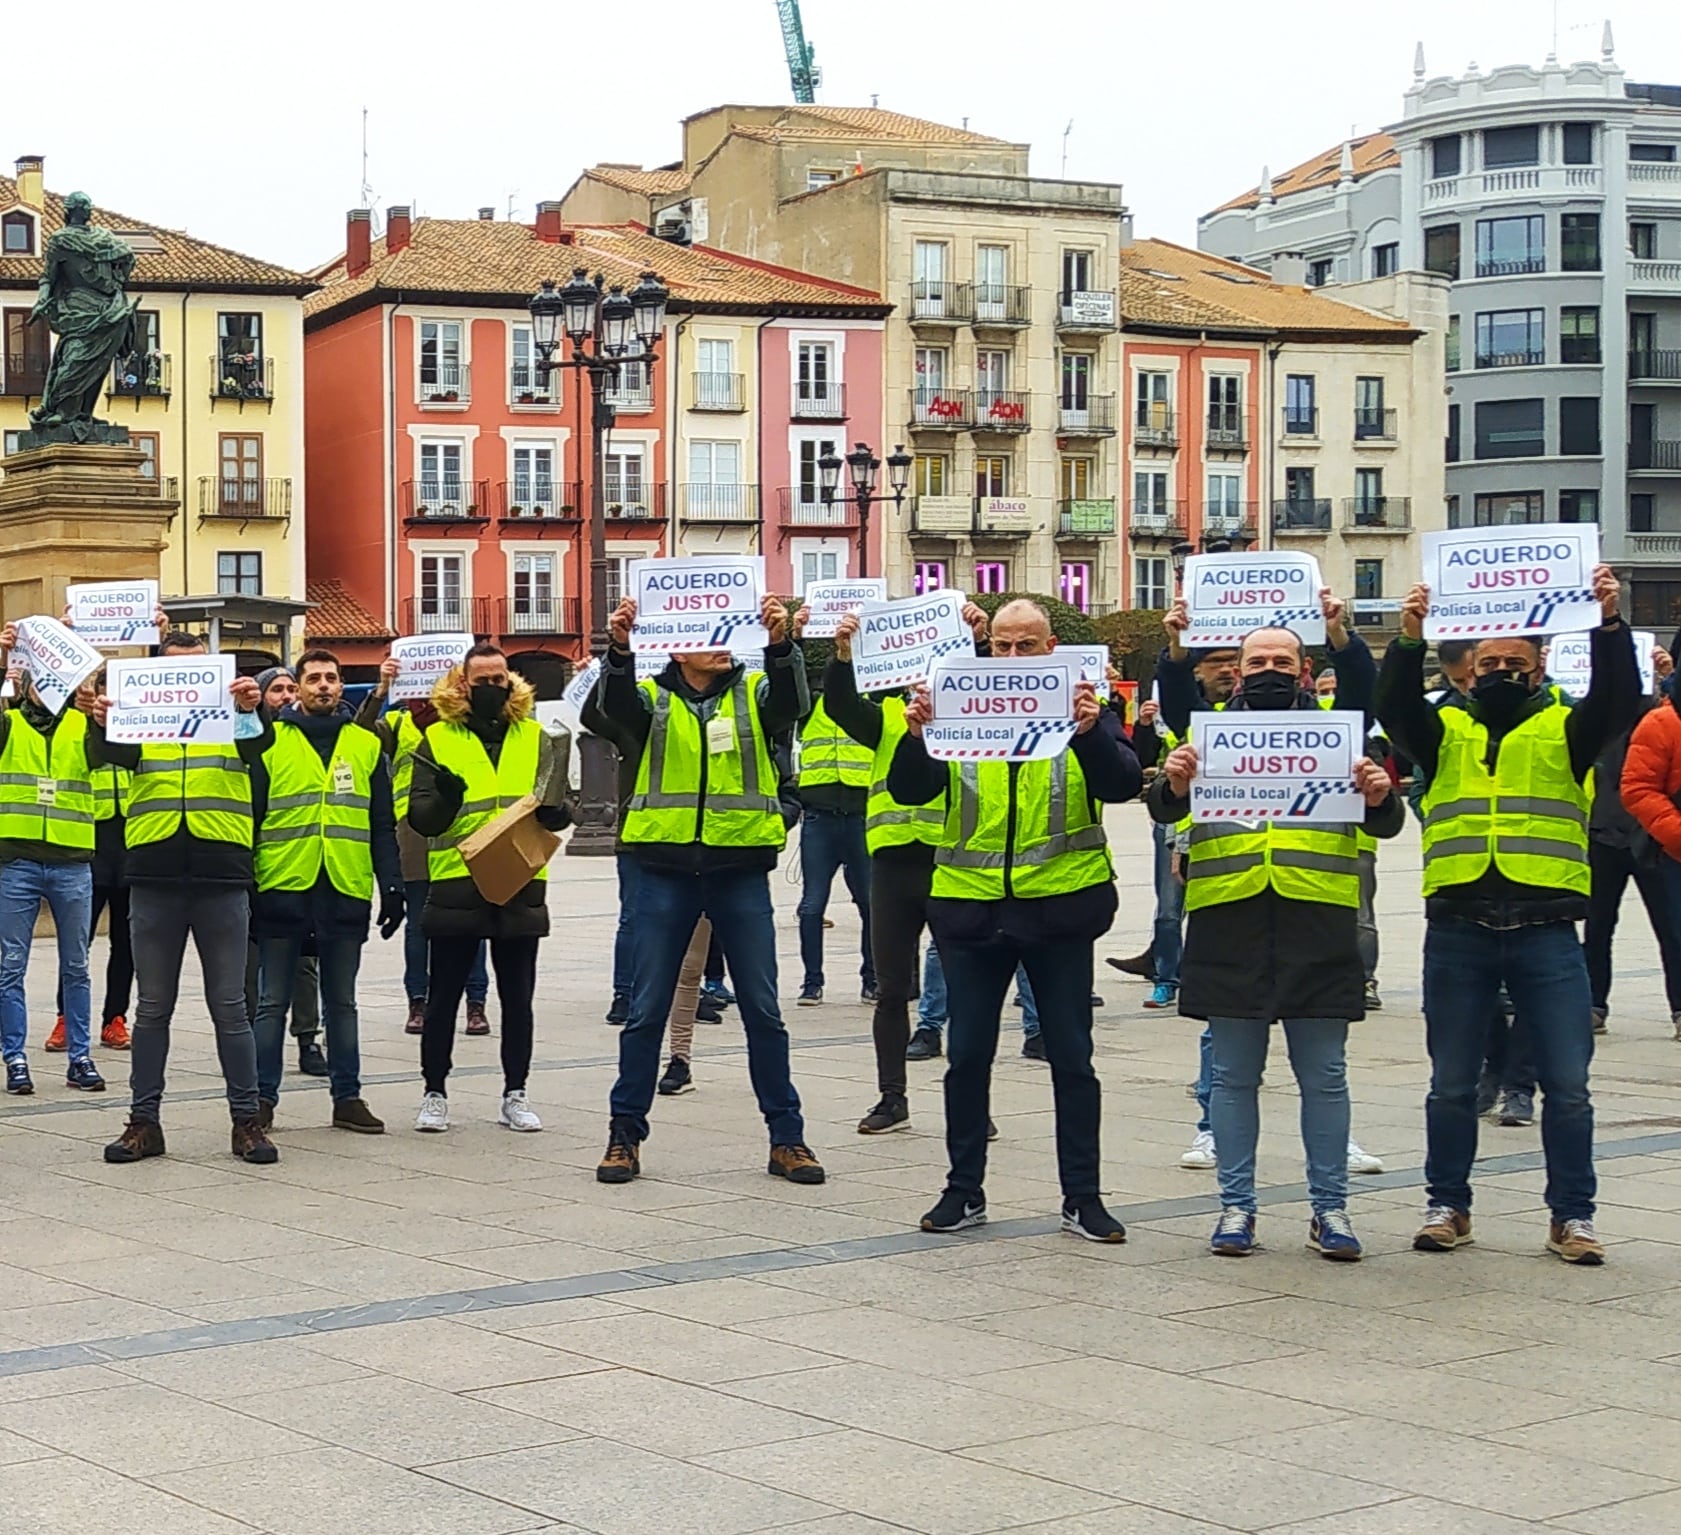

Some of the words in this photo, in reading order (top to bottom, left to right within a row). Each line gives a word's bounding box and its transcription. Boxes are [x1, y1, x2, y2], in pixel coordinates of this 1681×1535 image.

[988, 499, 1026, 510] ábaco
[1447, 543, 1571, 567] ACUERDO
[646, 572, 748, 591] ACUERDO
[1201, 569, 1305, 585] ACUERDO
[1467, 568, 1550, 589] JUSTO
[80, 593, 145, 604] ACUERDO
[814, 588, 875, 599] ACUERDO
[1217, 589, 1285, 605] JUSTO
[662, 593, 730, 611] JUSTO
[1430, 602, 1482, 618] Policía
[1486, 600, 1526, 615] Local
[90, 606, 133, 617] JUSTO
[865, 603, 951, 635] ACUERDO
[99, 624, 120, 632] Local
[632, 622, 674, 635] Policía
[677, 621, 710, 634] Local
[809, 618, 830, 626] olicía
[1231, 615, 1264, 627] Local
[26, 619, 83, 666] ACUERDO
[880, 626, 939, 651] JUSTO
[399, 644, 463, 658] ACUERDO
[410, 659, 454, 671] JUSTO
[857, 660, 894, 676] Policía
[896, 653, 926, 670] Local
[125, 671, 215, 687] ACUERDO
[420, 675, 438, 686] Loca
[572, 668, 600, 702] ACUER
[941, 675, 1060, 691] ACUERDO
[139, 690, 199, 704] JUSTO
[961, 696, 1038, 714] JUSTO
[112, 714, 149, 725] Policía
[151, 714, 181, 724] Local
[926, 727, 972, 741] Policía
[977, 727, 1015, 740] Local
[1213, 731, 1342, 749] ACUERDO
[1233, 755, 1318, 774] JUSTO
[1194, 785, 1247, 800] Policía
[1251, 786, 1291, 799] Local
